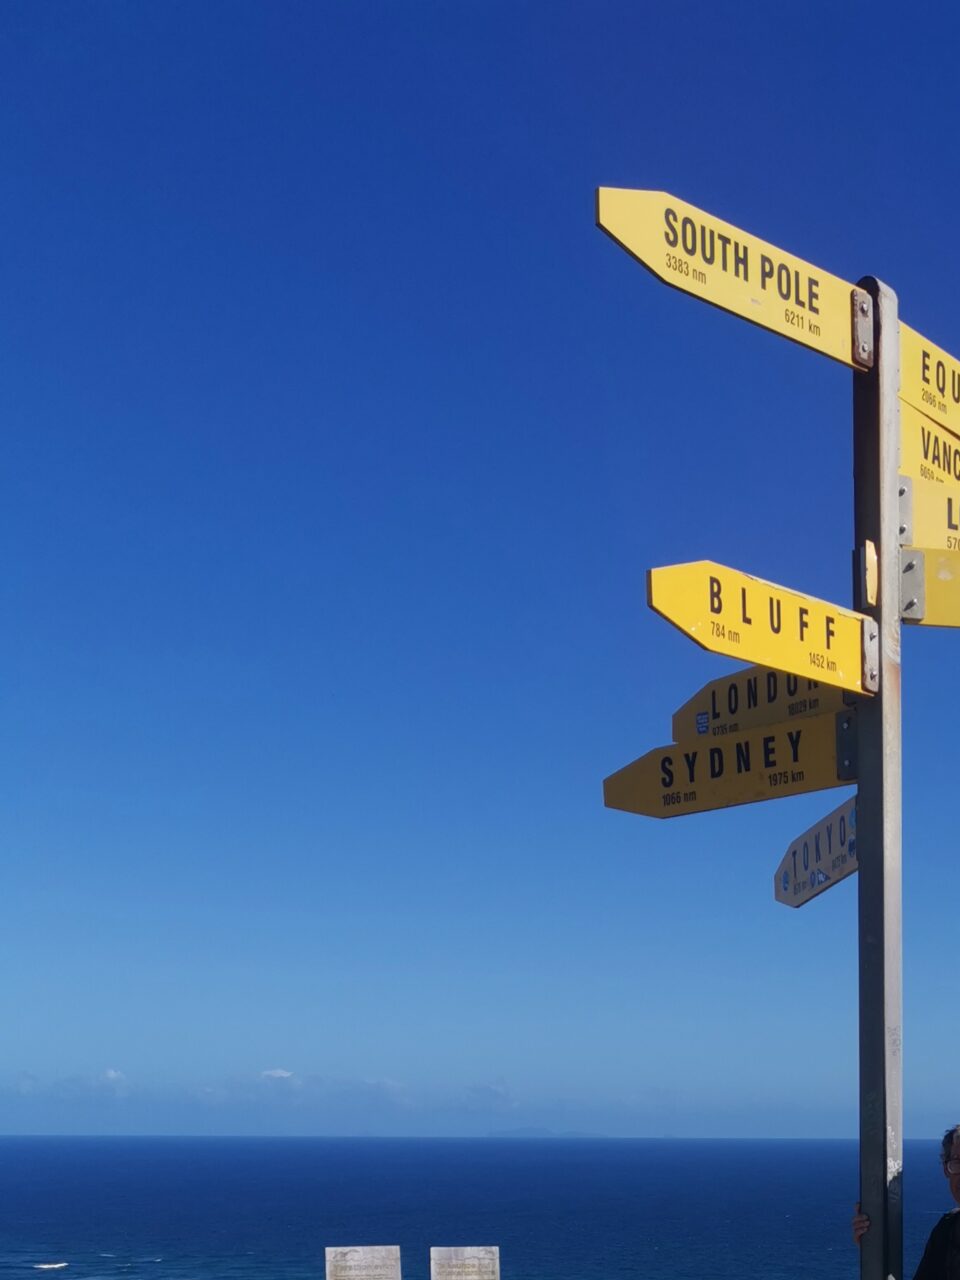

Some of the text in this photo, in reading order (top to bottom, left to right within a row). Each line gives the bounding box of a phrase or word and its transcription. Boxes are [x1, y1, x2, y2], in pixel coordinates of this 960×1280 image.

[664, 208, 820, 315] SOUTH POLE
[666, 253, 706, 285] 3383 nm
[784, 309, 820, 336] 6211 km
[710, 576, 836, 650] BLUFF
[710, 621, 740, 644] 784 nm
[808, 652, 837, 672] 1452 km
[660, 731, 802, 788] SYDNEY
[768, 770, 804, 788] 1975 km
[662, 790, 697, 807] 1066 nm
[792, 815, 847, 878] TOKYO
